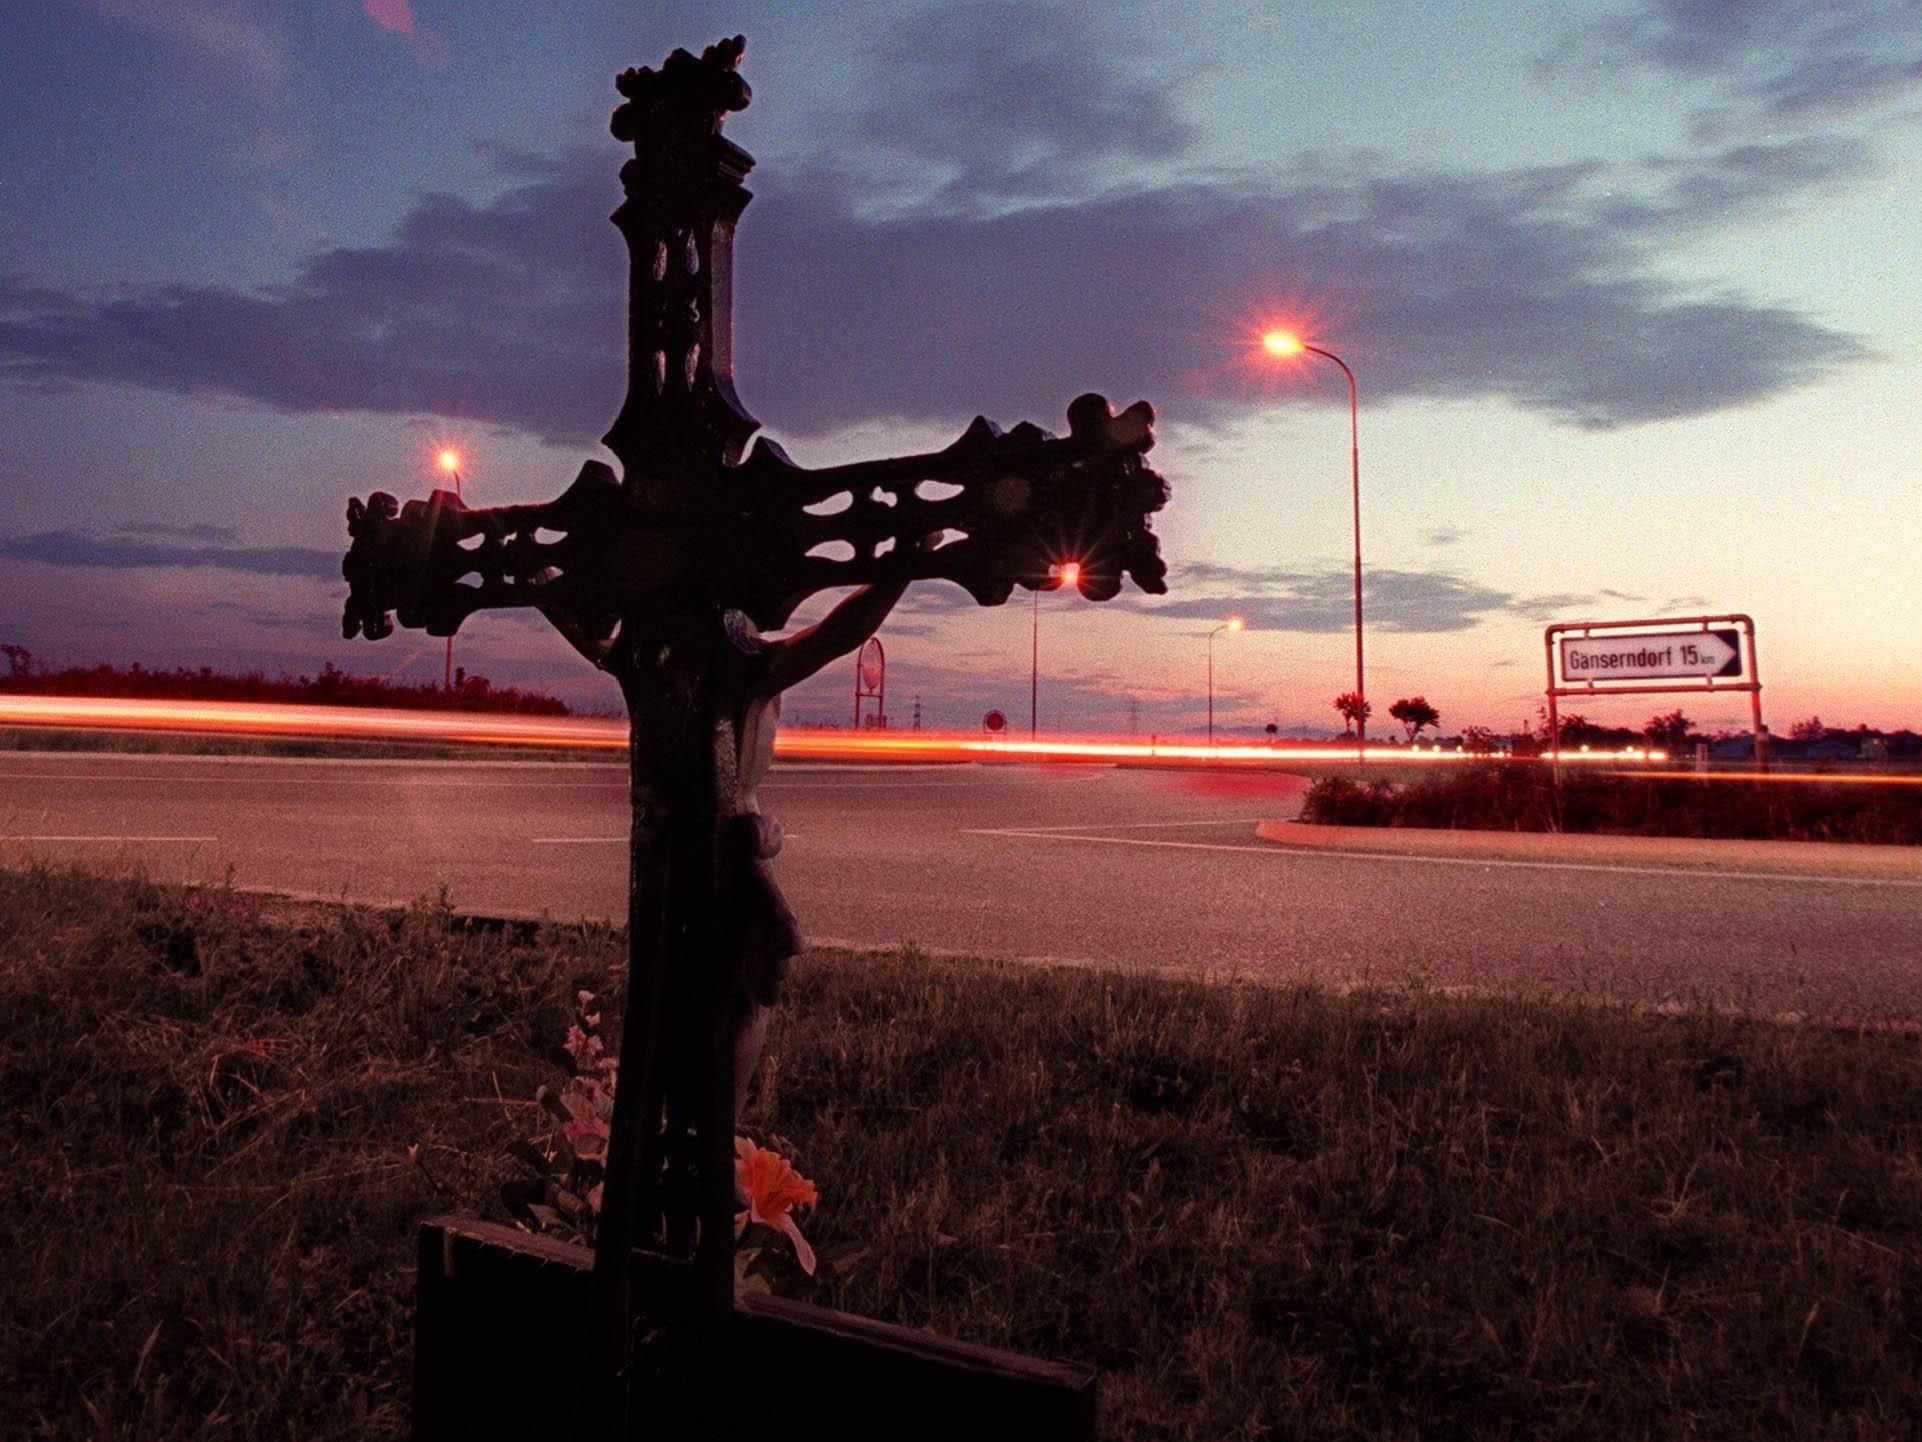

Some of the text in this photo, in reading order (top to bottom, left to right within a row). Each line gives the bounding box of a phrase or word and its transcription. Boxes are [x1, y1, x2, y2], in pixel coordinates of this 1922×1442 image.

[1570, 645, 1715, 669] Gänserndorf 15 km
